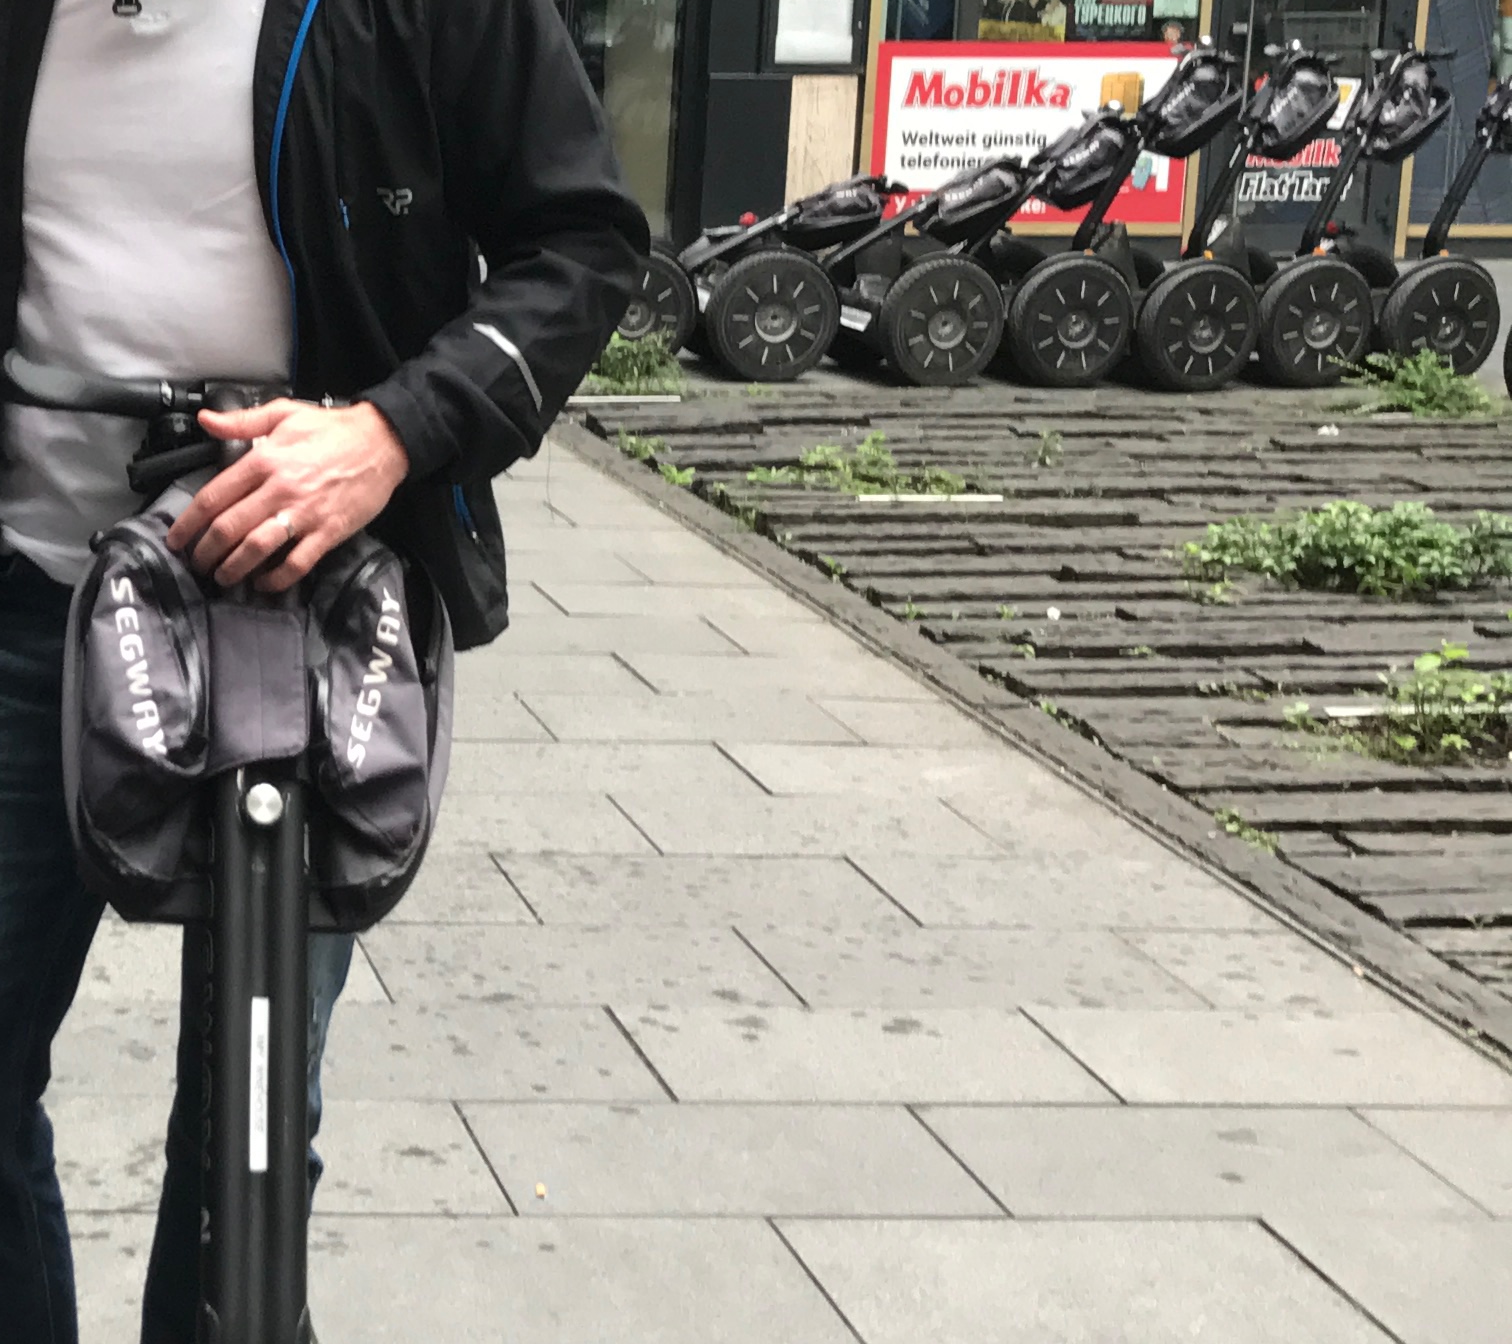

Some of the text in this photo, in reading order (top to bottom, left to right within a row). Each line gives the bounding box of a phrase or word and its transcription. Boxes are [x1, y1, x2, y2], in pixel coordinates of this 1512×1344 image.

[900, 67, 1074, 110] Mobilka
[901, 130, 1047, 151] Weltweit günstig
[1239, 170, 1289, 202] Flat
[110, 576, 168, 757] SEGWAY
[346, 586, 403, 770] SEGWAY
